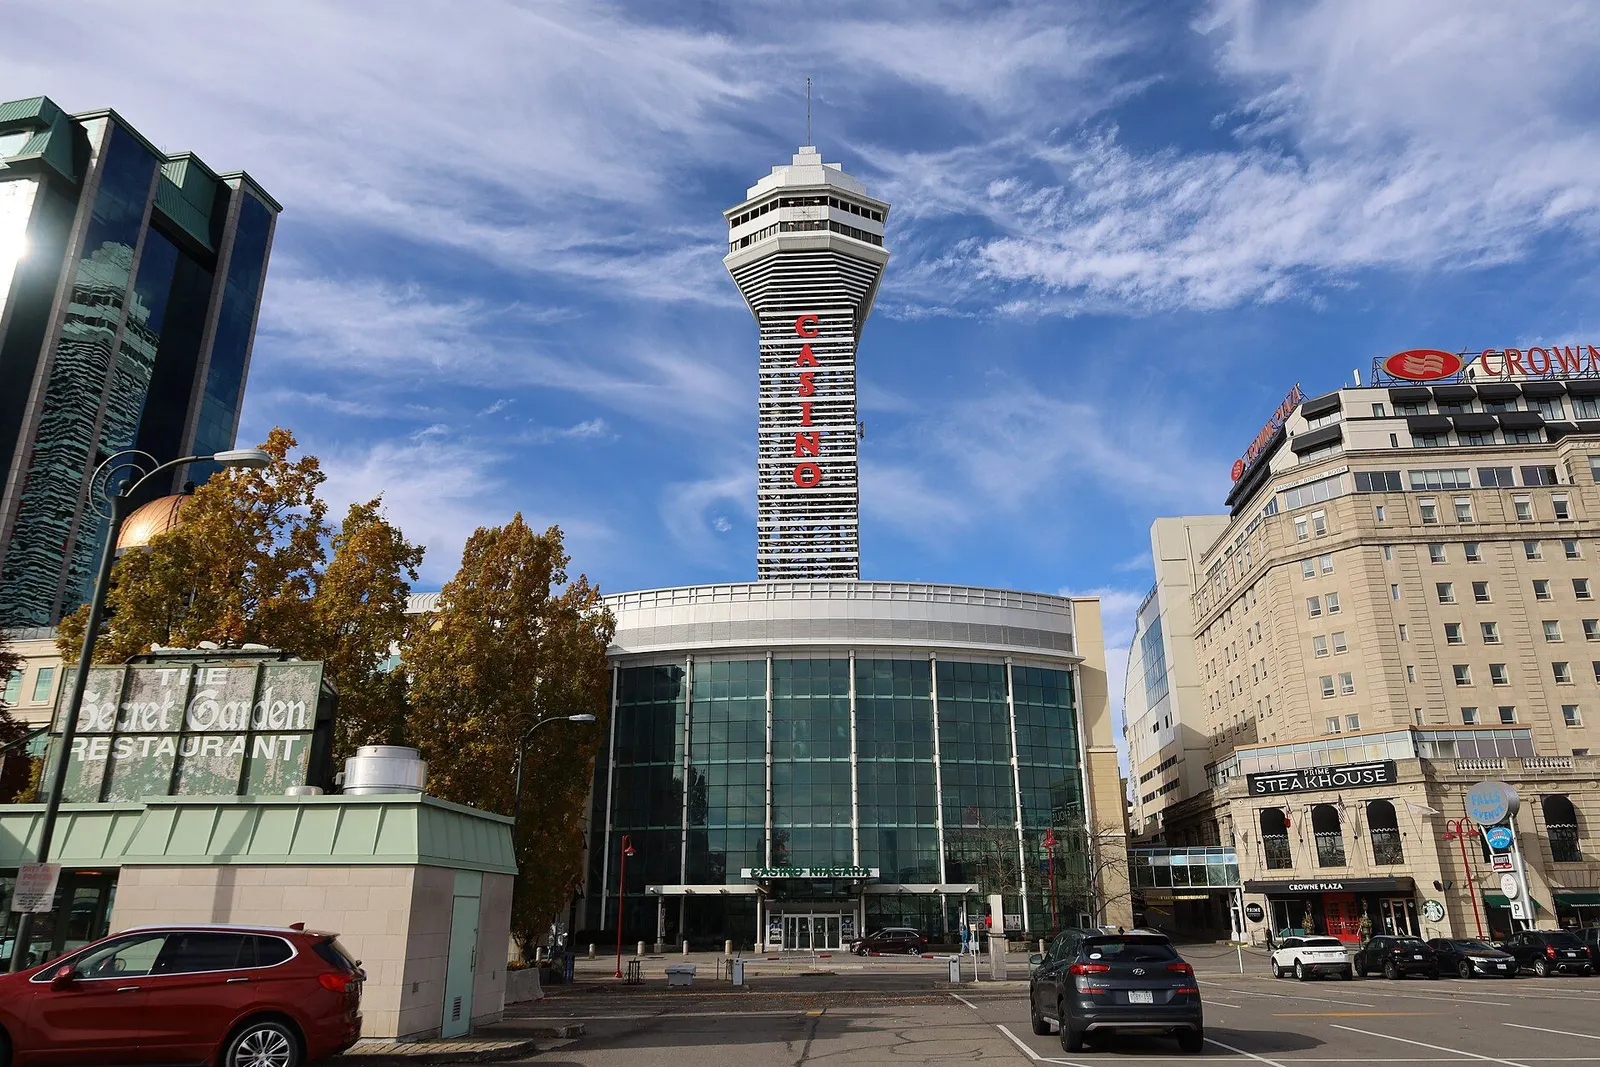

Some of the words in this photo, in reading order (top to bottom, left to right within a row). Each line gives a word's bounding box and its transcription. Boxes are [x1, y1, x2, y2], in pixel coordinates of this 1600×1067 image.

[793, 314, 822, 488] CASINO
[154, 668, 229, 686] THE
[77, 689, 175, 732] Secret
[187, 687, 306, 731] Garden
[70, 735, 301, 762] RESTAURANT
[1256, 769, 1387, 793] STEAKHOUSE
[1303, 767, 1330, 776] PRIME
[750, 866, 804, 879] CASINO
[809, 866, 872, 879] NIAGARA
[1289, 883, 1319, 891] CROWNE
